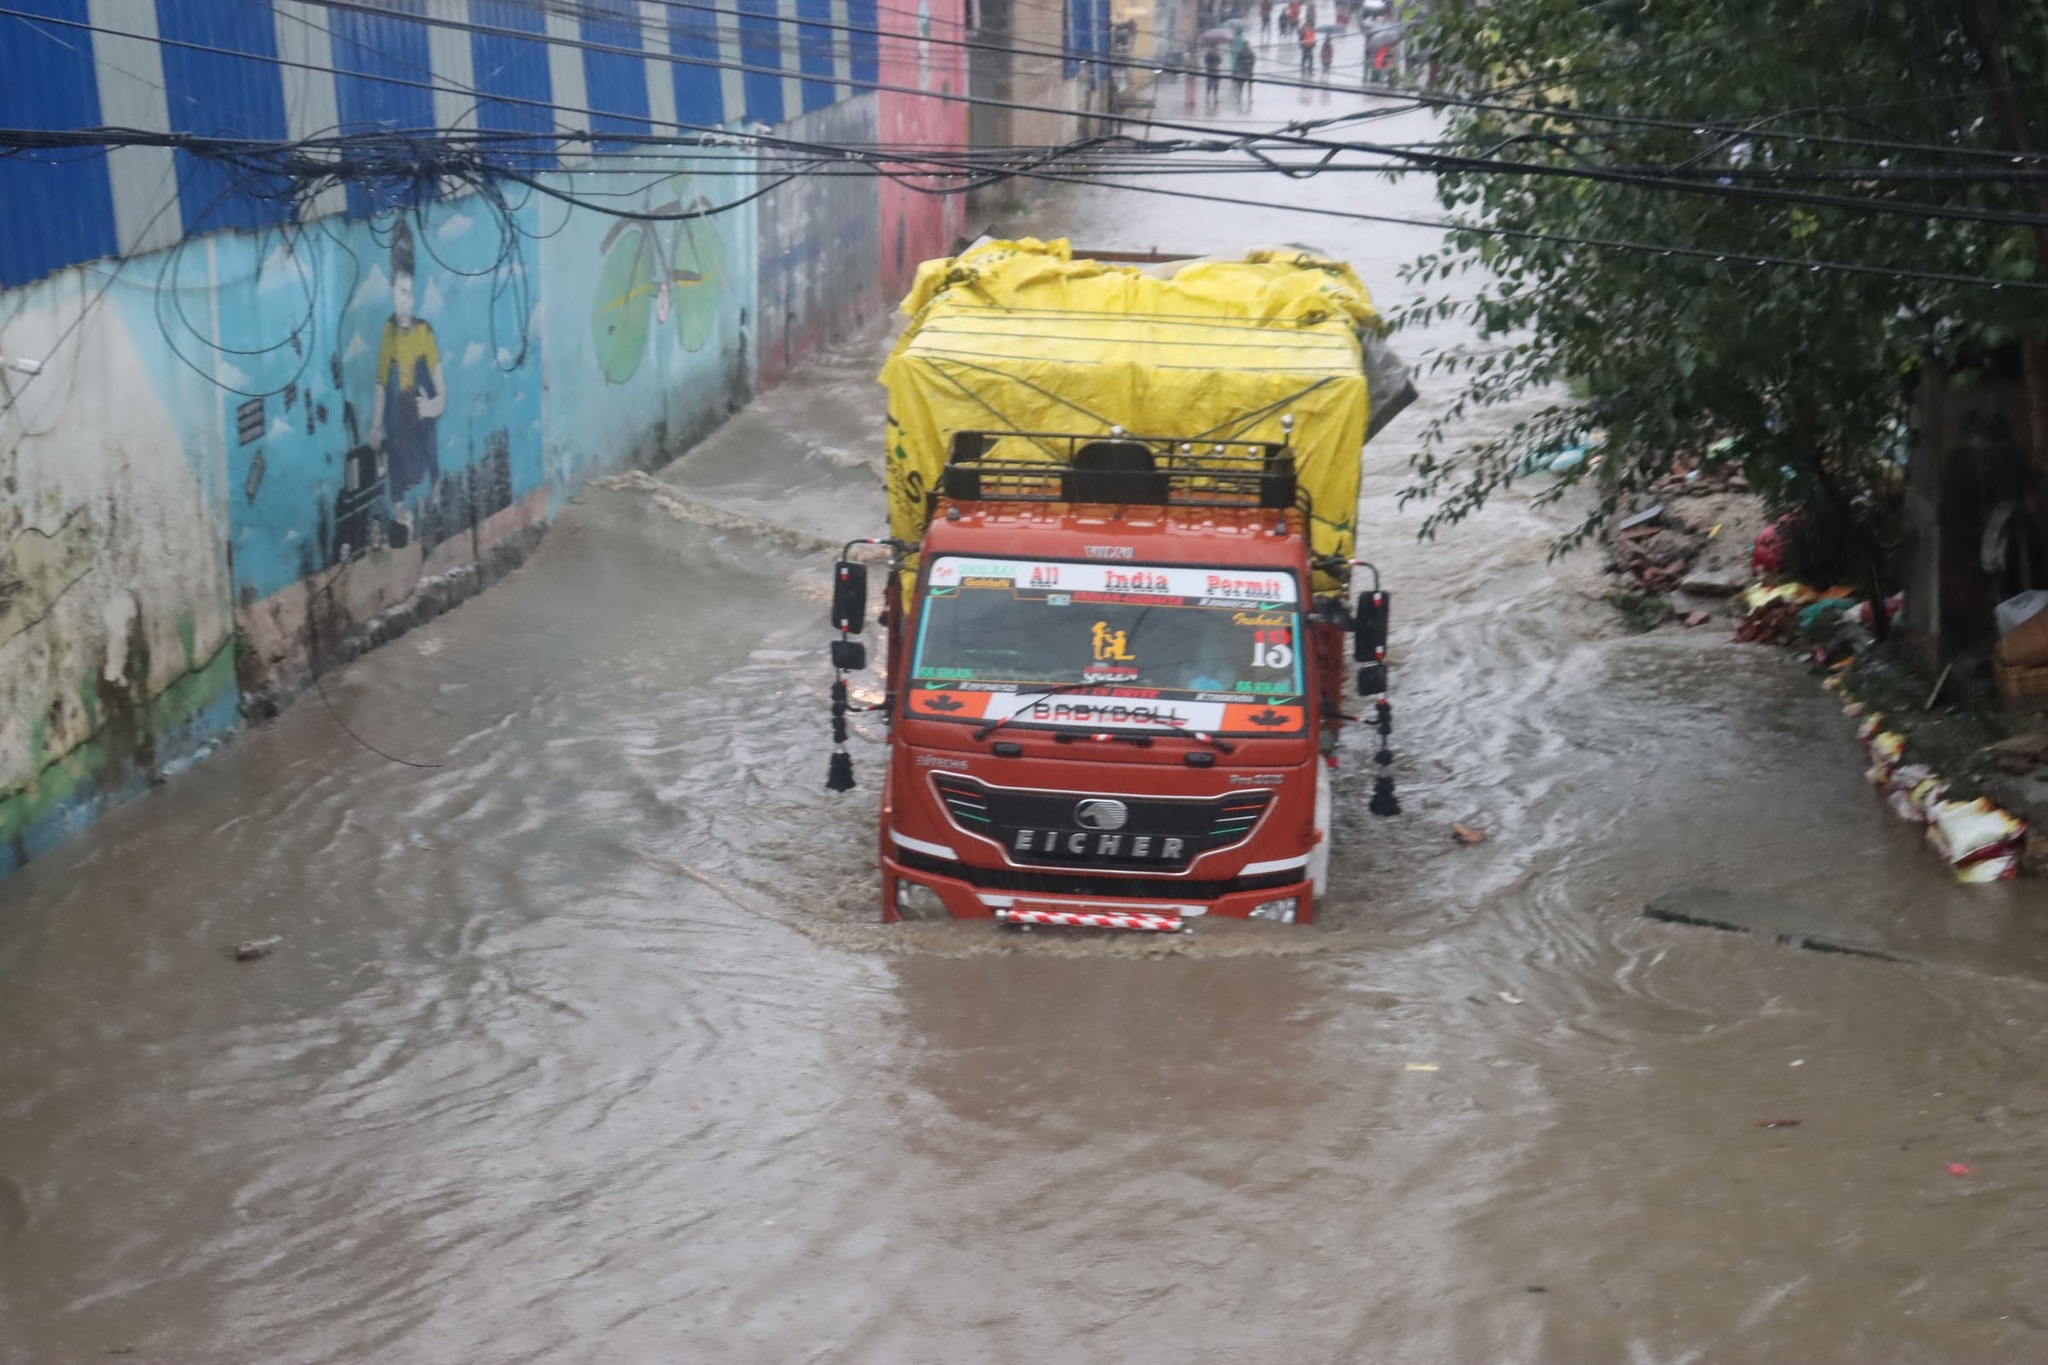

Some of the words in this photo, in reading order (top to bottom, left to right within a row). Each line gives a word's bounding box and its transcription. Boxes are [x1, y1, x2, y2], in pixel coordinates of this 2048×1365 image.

[1030, 567, 1060, 586] All
[1104, 571, 1168, 592] India
[1205, 575, 1281, 598] Permit
[1111, 687, 1159, 699] DRIVE
[1015, 830, 1184, 858] EICHER
